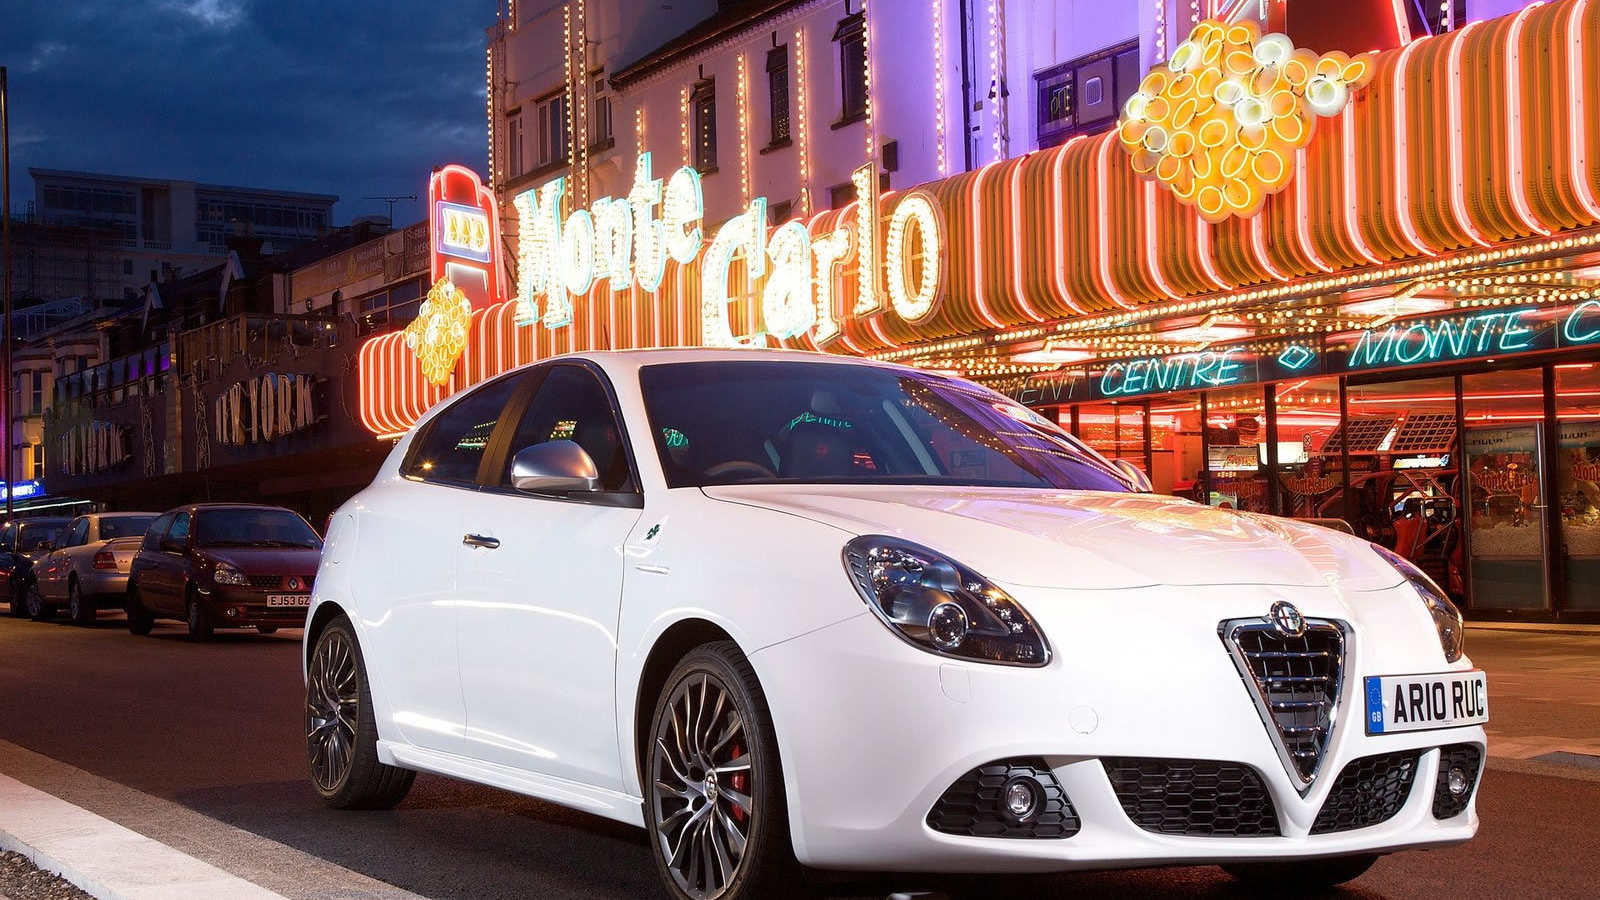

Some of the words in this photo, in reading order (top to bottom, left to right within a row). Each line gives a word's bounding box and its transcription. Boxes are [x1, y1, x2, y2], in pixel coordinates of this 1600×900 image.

[513, 151, 704, 329] Monte
[702, 161, 947, 349] Carlo
[1100, 348, 1246, 397] CENTRE
[1349, 309, 1538, 368] MONTE
[248, 372, 314, 443] YORK
[270, 595, 296, 606] EJ53
[297, 595, 310, 606] GZ
[1371, 711, 1382, 723] GB
[1393, 682, 1447, 724] AR10
[1451, 679, 1484, 719] RUC
